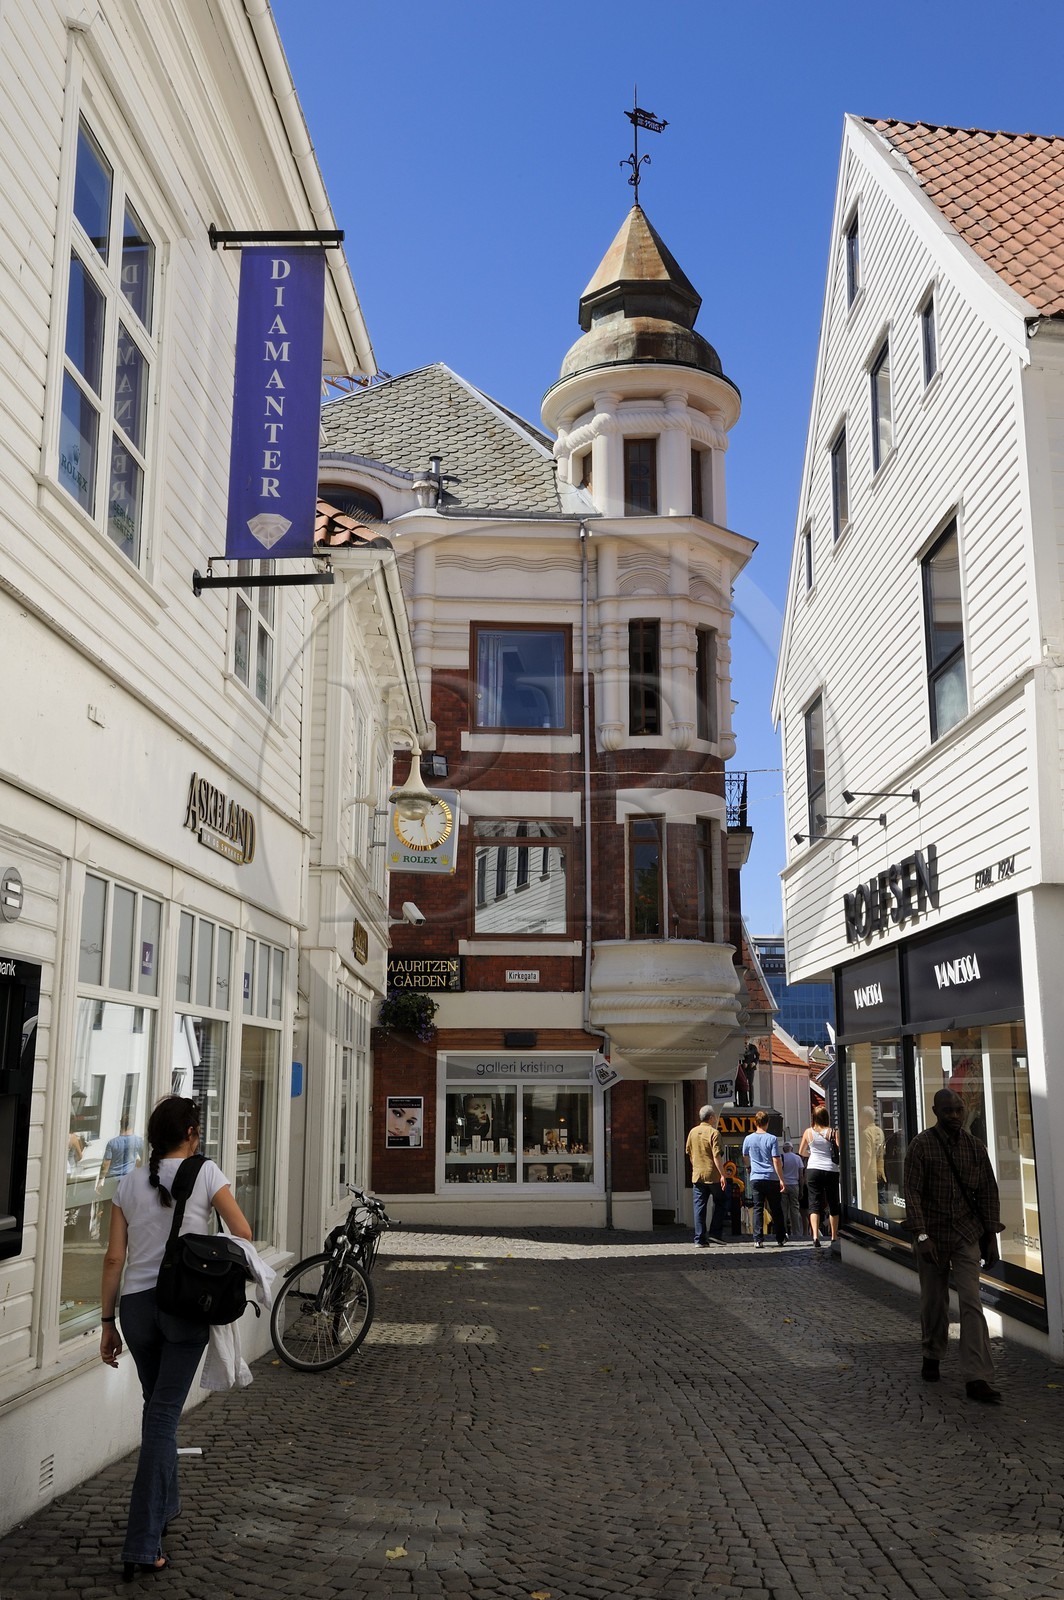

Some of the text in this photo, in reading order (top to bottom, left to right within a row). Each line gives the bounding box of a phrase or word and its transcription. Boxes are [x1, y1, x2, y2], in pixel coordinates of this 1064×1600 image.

[259, 258, 292, 499] DIAMANTER
[60, 453, 88, 493] ROLEX
[184, 772, 257, 864] ASKELAND
[403, 855, 438, 865] ROLEX
[844, 843, 941, 944] ROLFSEN
[393, 973, 447, 987] GÅRDEN
[508, 971, 537, 982] Kirkegata
[934, 952, 981, 990] VANESSA
[853, 981, 884, 1010] VANESSA
[476, 1061, 564, 1076] galleri kristina
